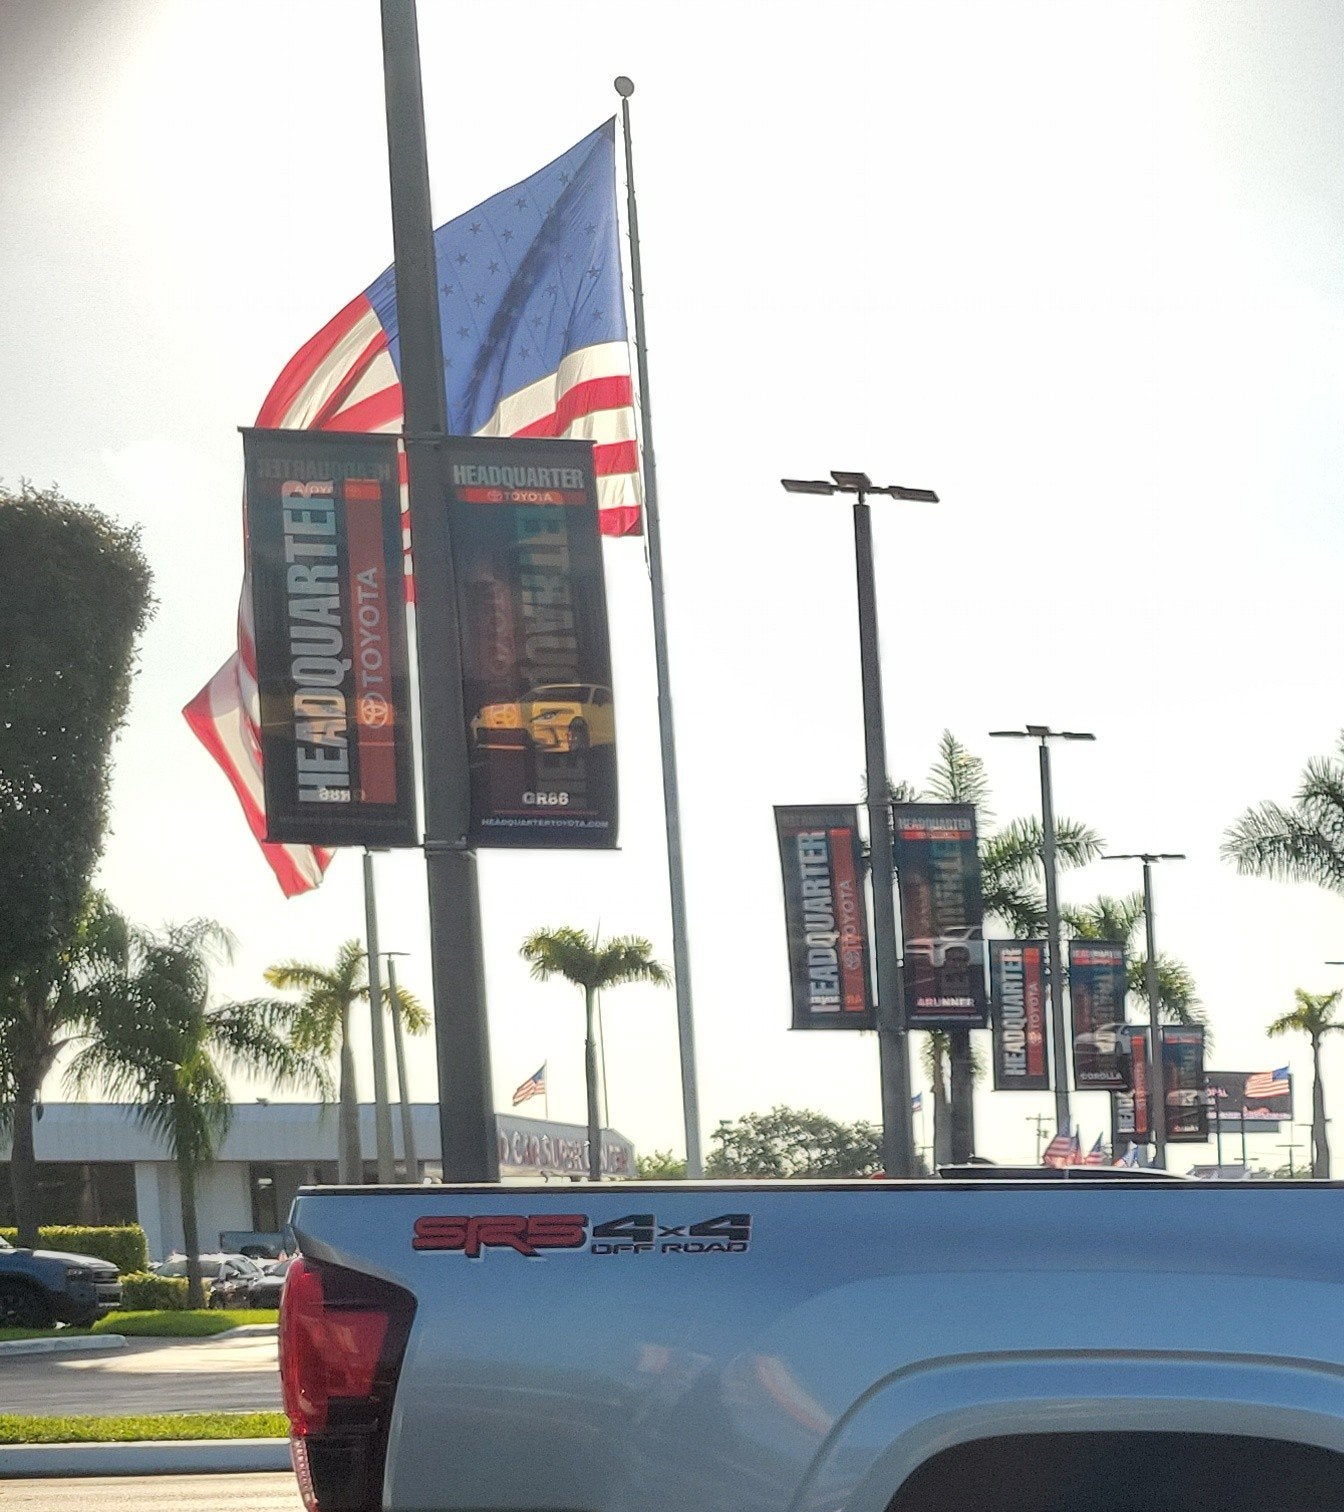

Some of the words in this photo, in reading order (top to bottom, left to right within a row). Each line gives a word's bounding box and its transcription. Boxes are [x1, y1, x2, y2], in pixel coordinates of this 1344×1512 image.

[454, 465, 584, 488] HEADQUARTER
[504, 492, 553, 501] TOYOTA
[282, 480, 351, 802] HEADQUARTER
[355, 566, 383, 686] TOYOTA
[522, 792, 570, 805] GR86
[798, 832, 841, 1013] HEADQUARTER
[840, 880, 858, 949] TOYOTA
[916, 996, 975, 1007] 4RUNNER
[1001, 949, 1027, 1076] HEADQUARTER
[412, 1214, 590, 1259] SR5
[591, 1243, 656, 1255] OFF
[661, 1242, 748, 1254] ROAD
